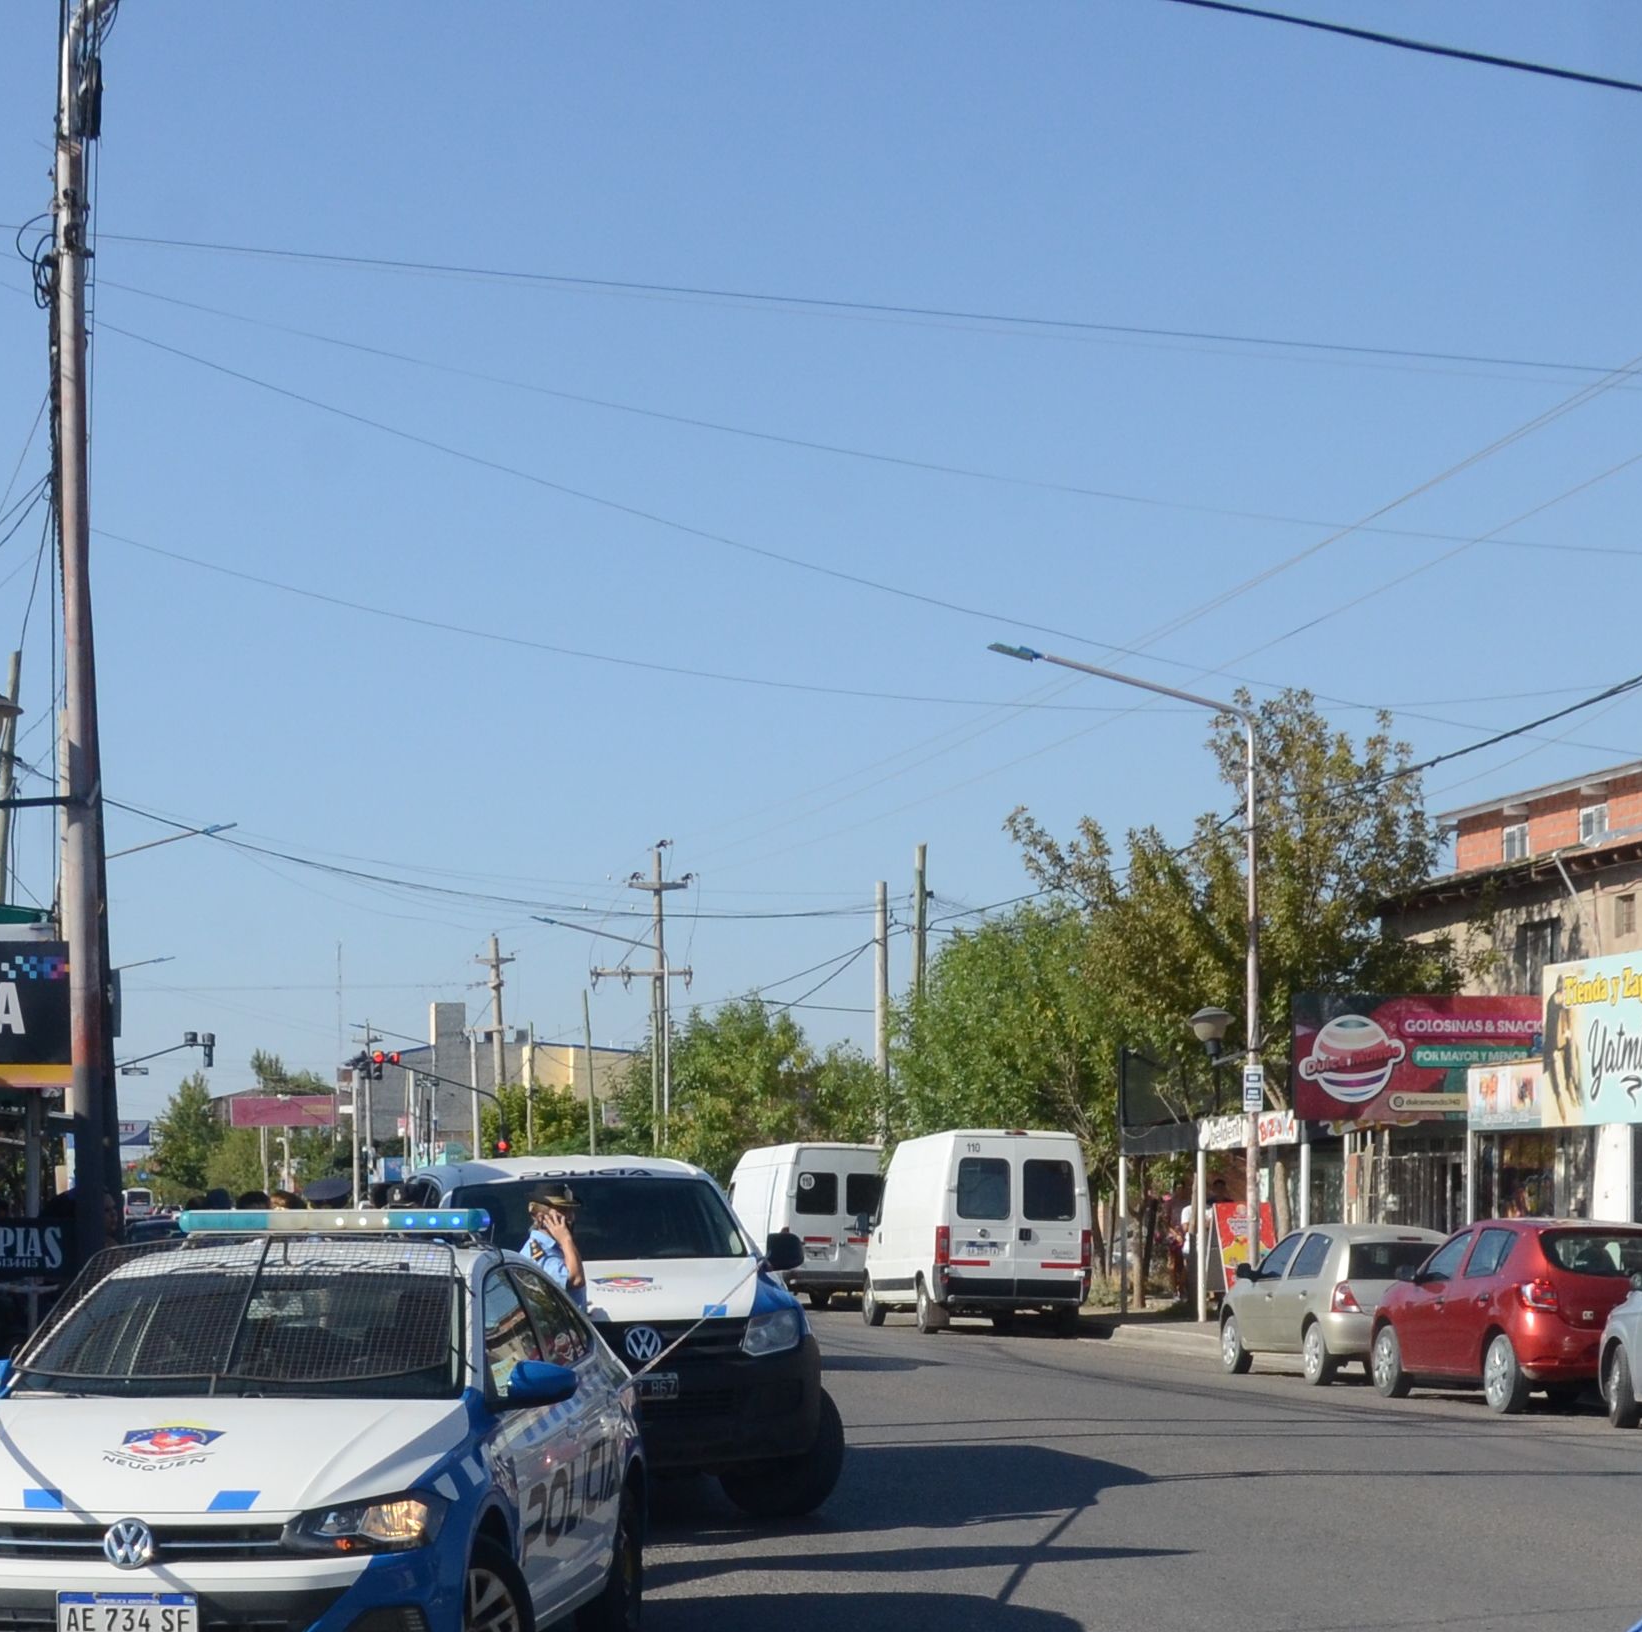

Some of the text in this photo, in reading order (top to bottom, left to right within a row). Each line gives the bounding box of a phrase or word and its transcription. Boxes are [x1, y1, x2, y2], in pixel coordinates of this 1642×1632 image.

[1563, 972, 1609, 1007] Tienda
[1610, 980, 1620, 1006] y
[1404, 1018, 1483, 1033] GOLOSINAS
[1484, 1018, 1496, 1033] &
[1416, 1051, 1528, 1062] POR MAYOR Y MENOR
[966, 1142, 981, 1153] 110
[519, 1168, 653, 1180] POLICIA
[102, 1455, 208, 1472] NEUQUEN
[521, 1436, 622, 1569] POLICIA
[66, 1607, 190, 1632] AE 734 SF
